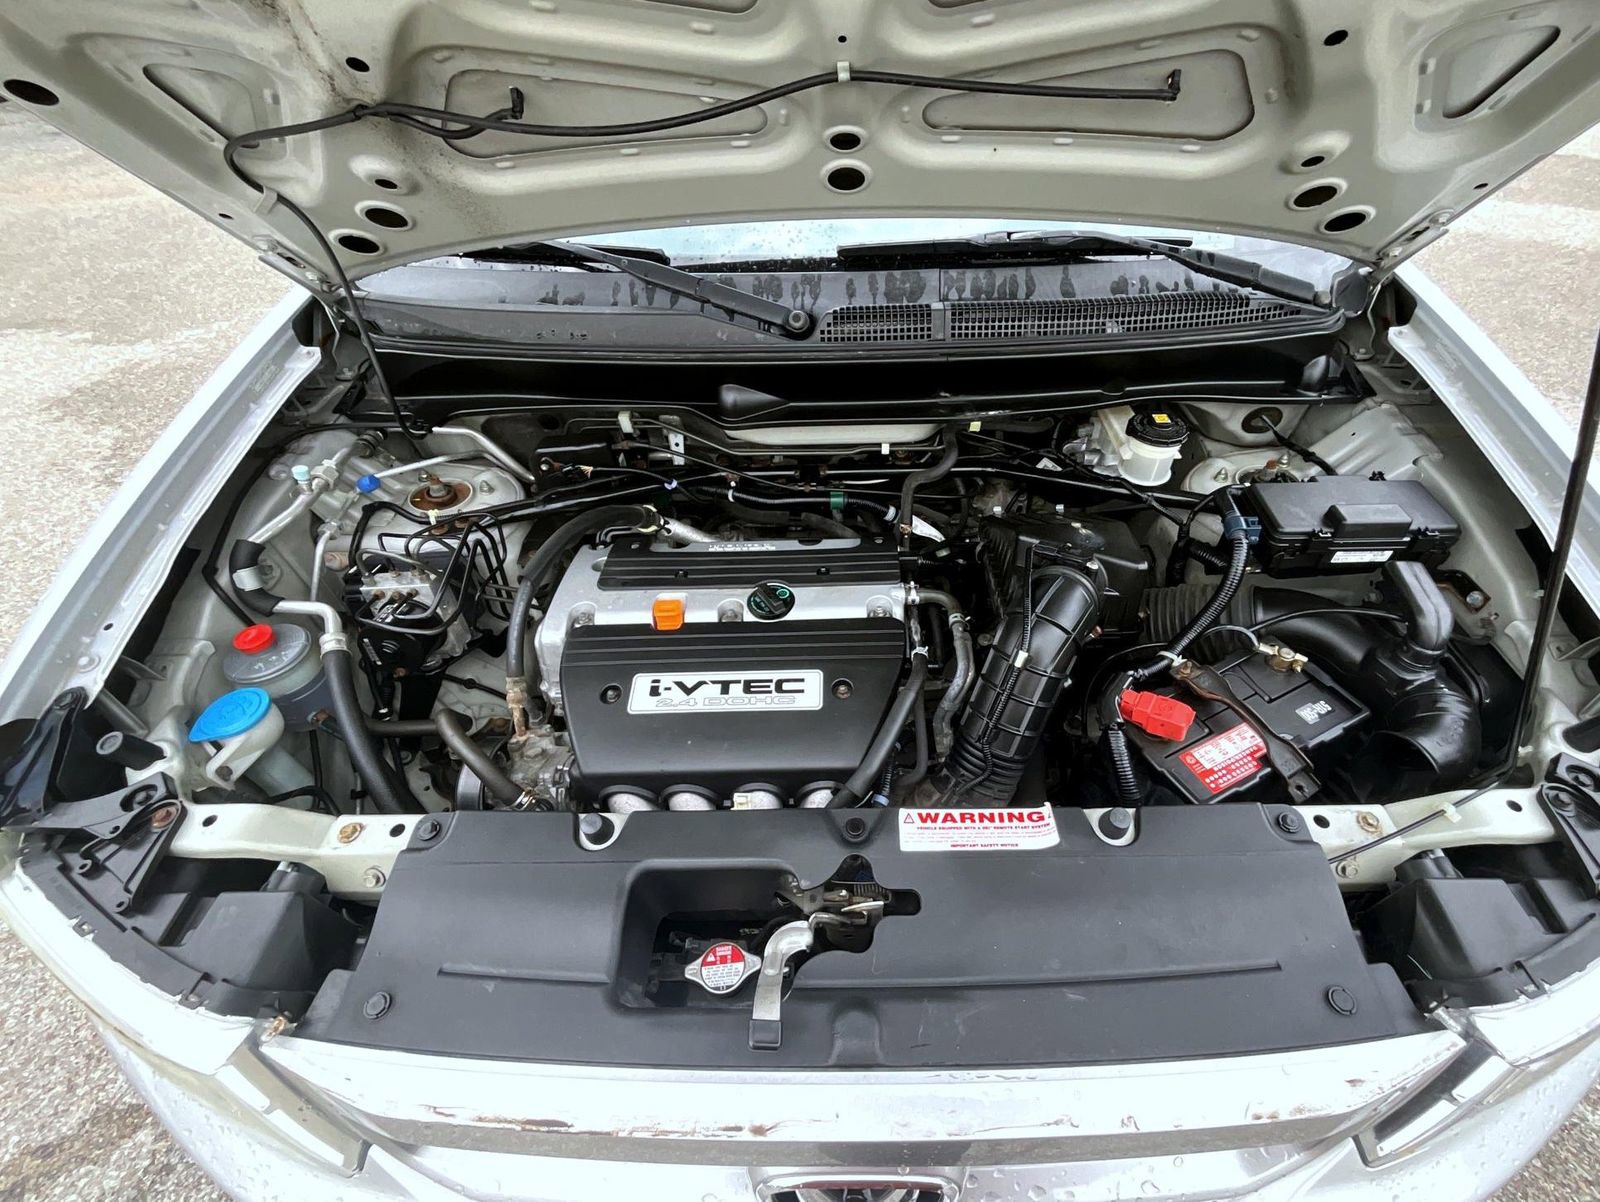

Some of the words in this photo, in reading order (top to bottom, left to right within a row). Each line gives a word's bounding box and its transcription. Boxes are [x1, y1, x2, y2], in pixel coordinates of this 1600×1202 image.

[649, 678, 805, 697] i-VTEC
[656, 697, 698, 708] 2.4
[703, 696, 796, 706] DOHC
[917, 811, 1045, 824] WARNING
